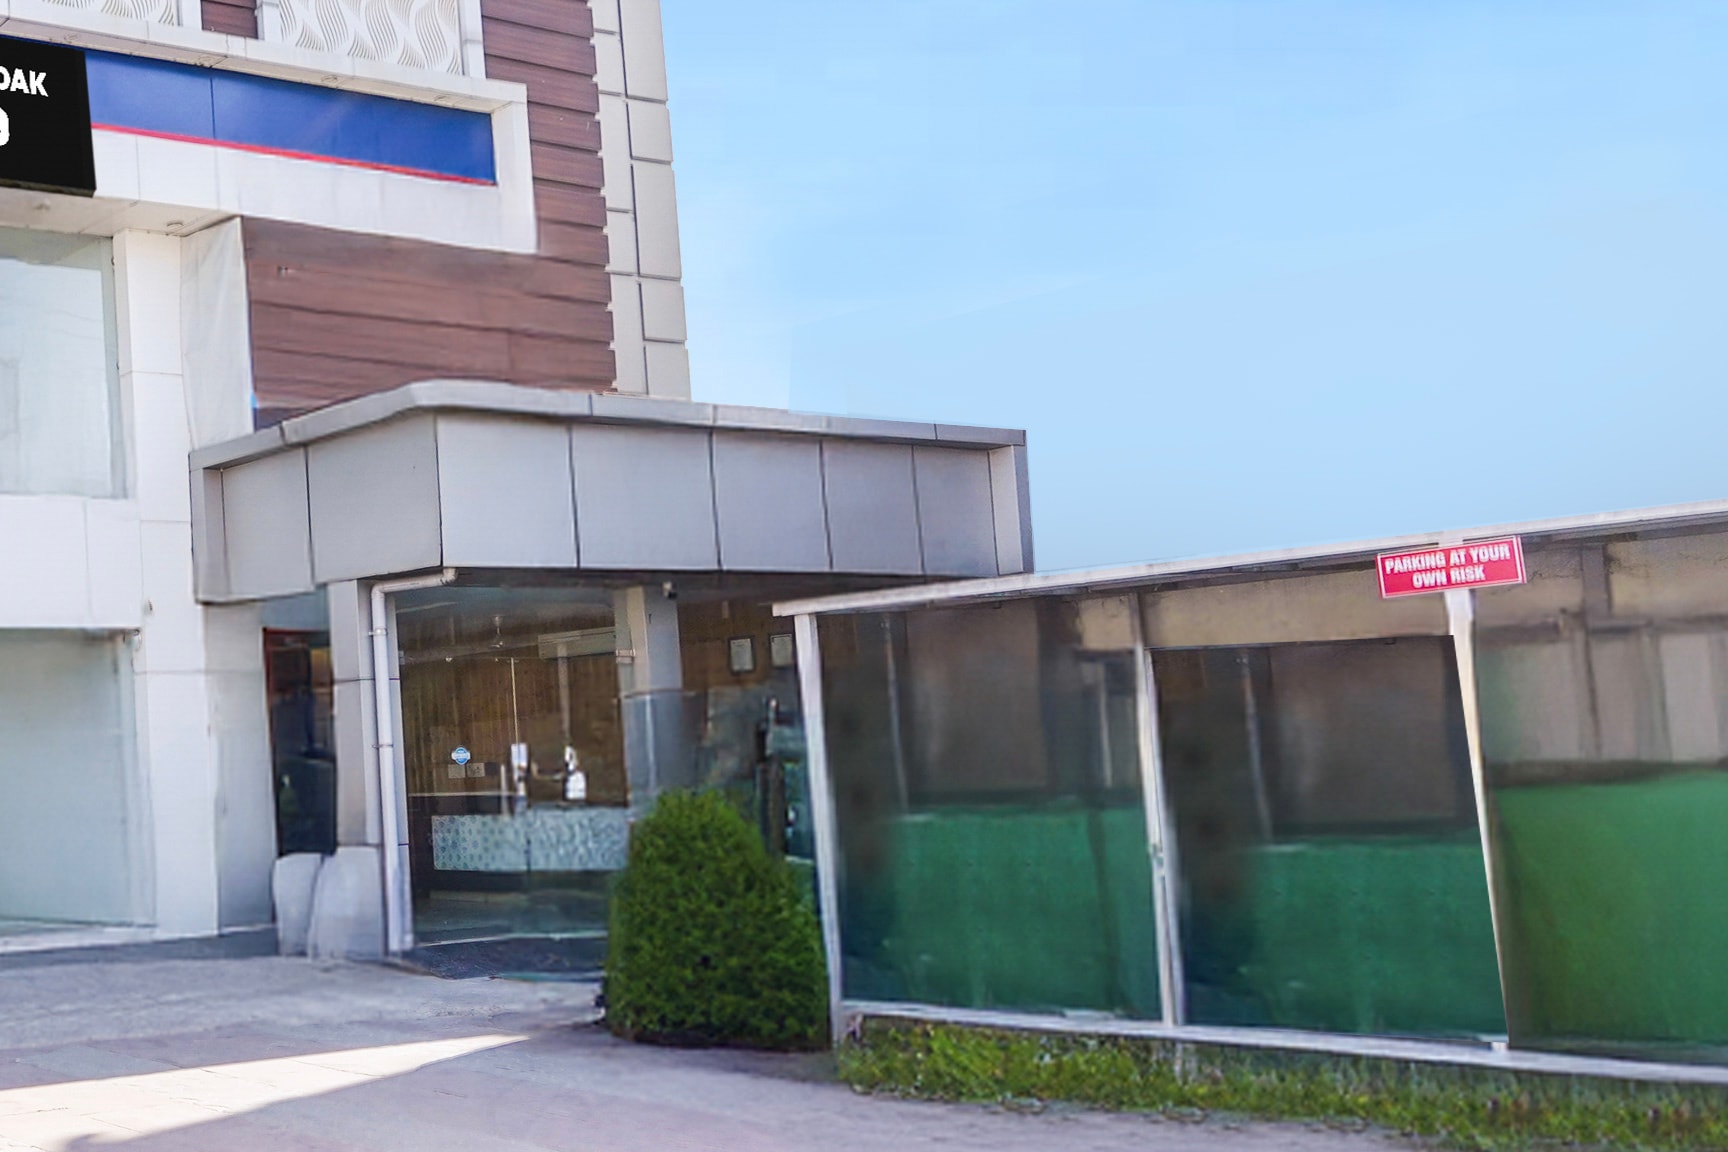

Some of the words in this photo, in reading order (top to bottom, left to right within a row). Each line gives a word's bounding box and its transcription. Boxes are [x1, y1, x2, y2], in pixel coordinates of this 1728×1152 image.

[1385, 552, 1445, 574] PARKING
[1450, 548, 1467, 565] AT
[1469, 544, 1510, 562] YOUR
[1412, 571, 1447, 588] OWN
[1450, 565, 1485, 584] RISK
